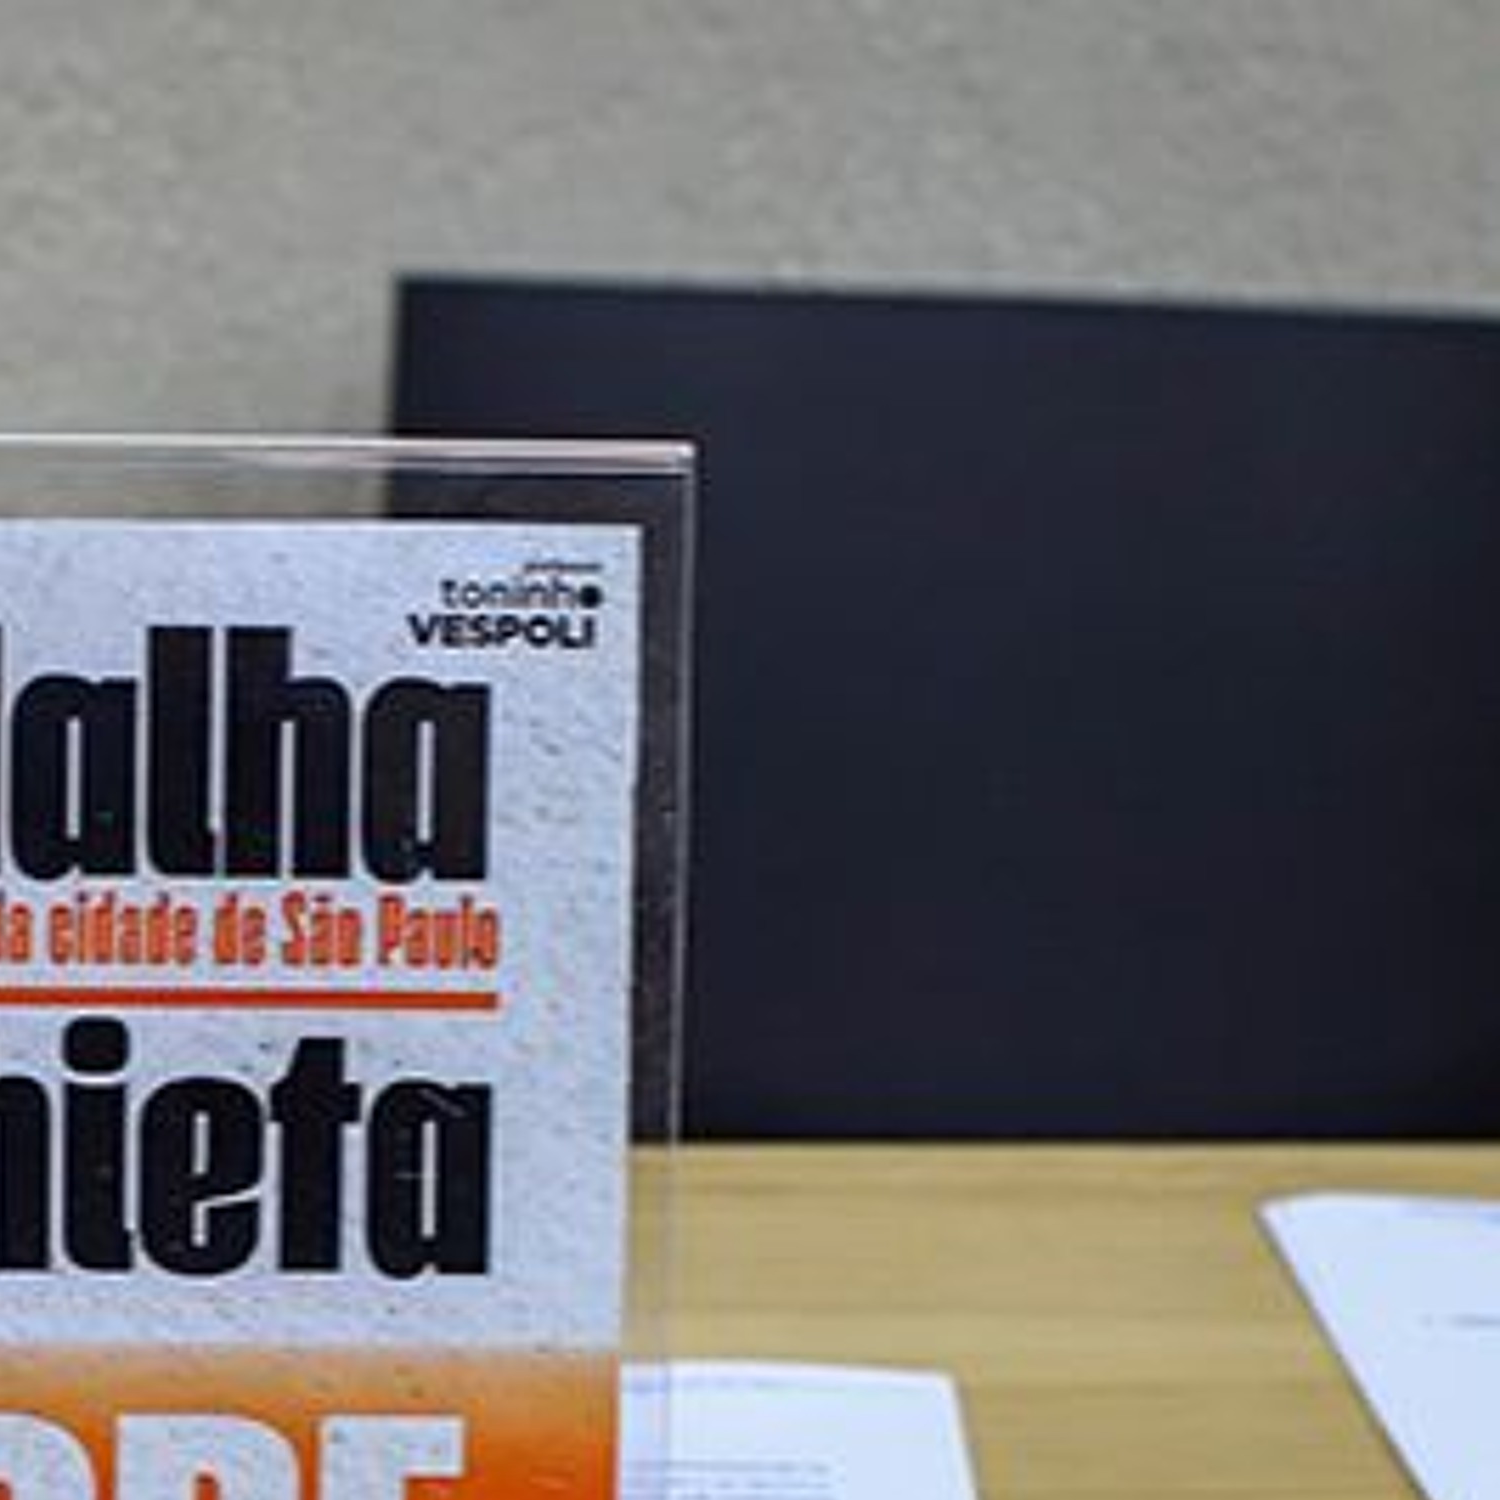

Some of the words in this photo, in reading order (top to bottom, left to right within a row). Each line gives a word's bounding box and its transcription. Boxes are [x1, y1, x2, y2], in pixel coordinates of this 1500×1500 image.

[405, 613, 596, 650] VESPOLI
[49, 890, 198, 965] cidade
[213, 890, 267, 965] de
[281, 890, 362, 966] São
[378, 892, 498, 969] Paulo
